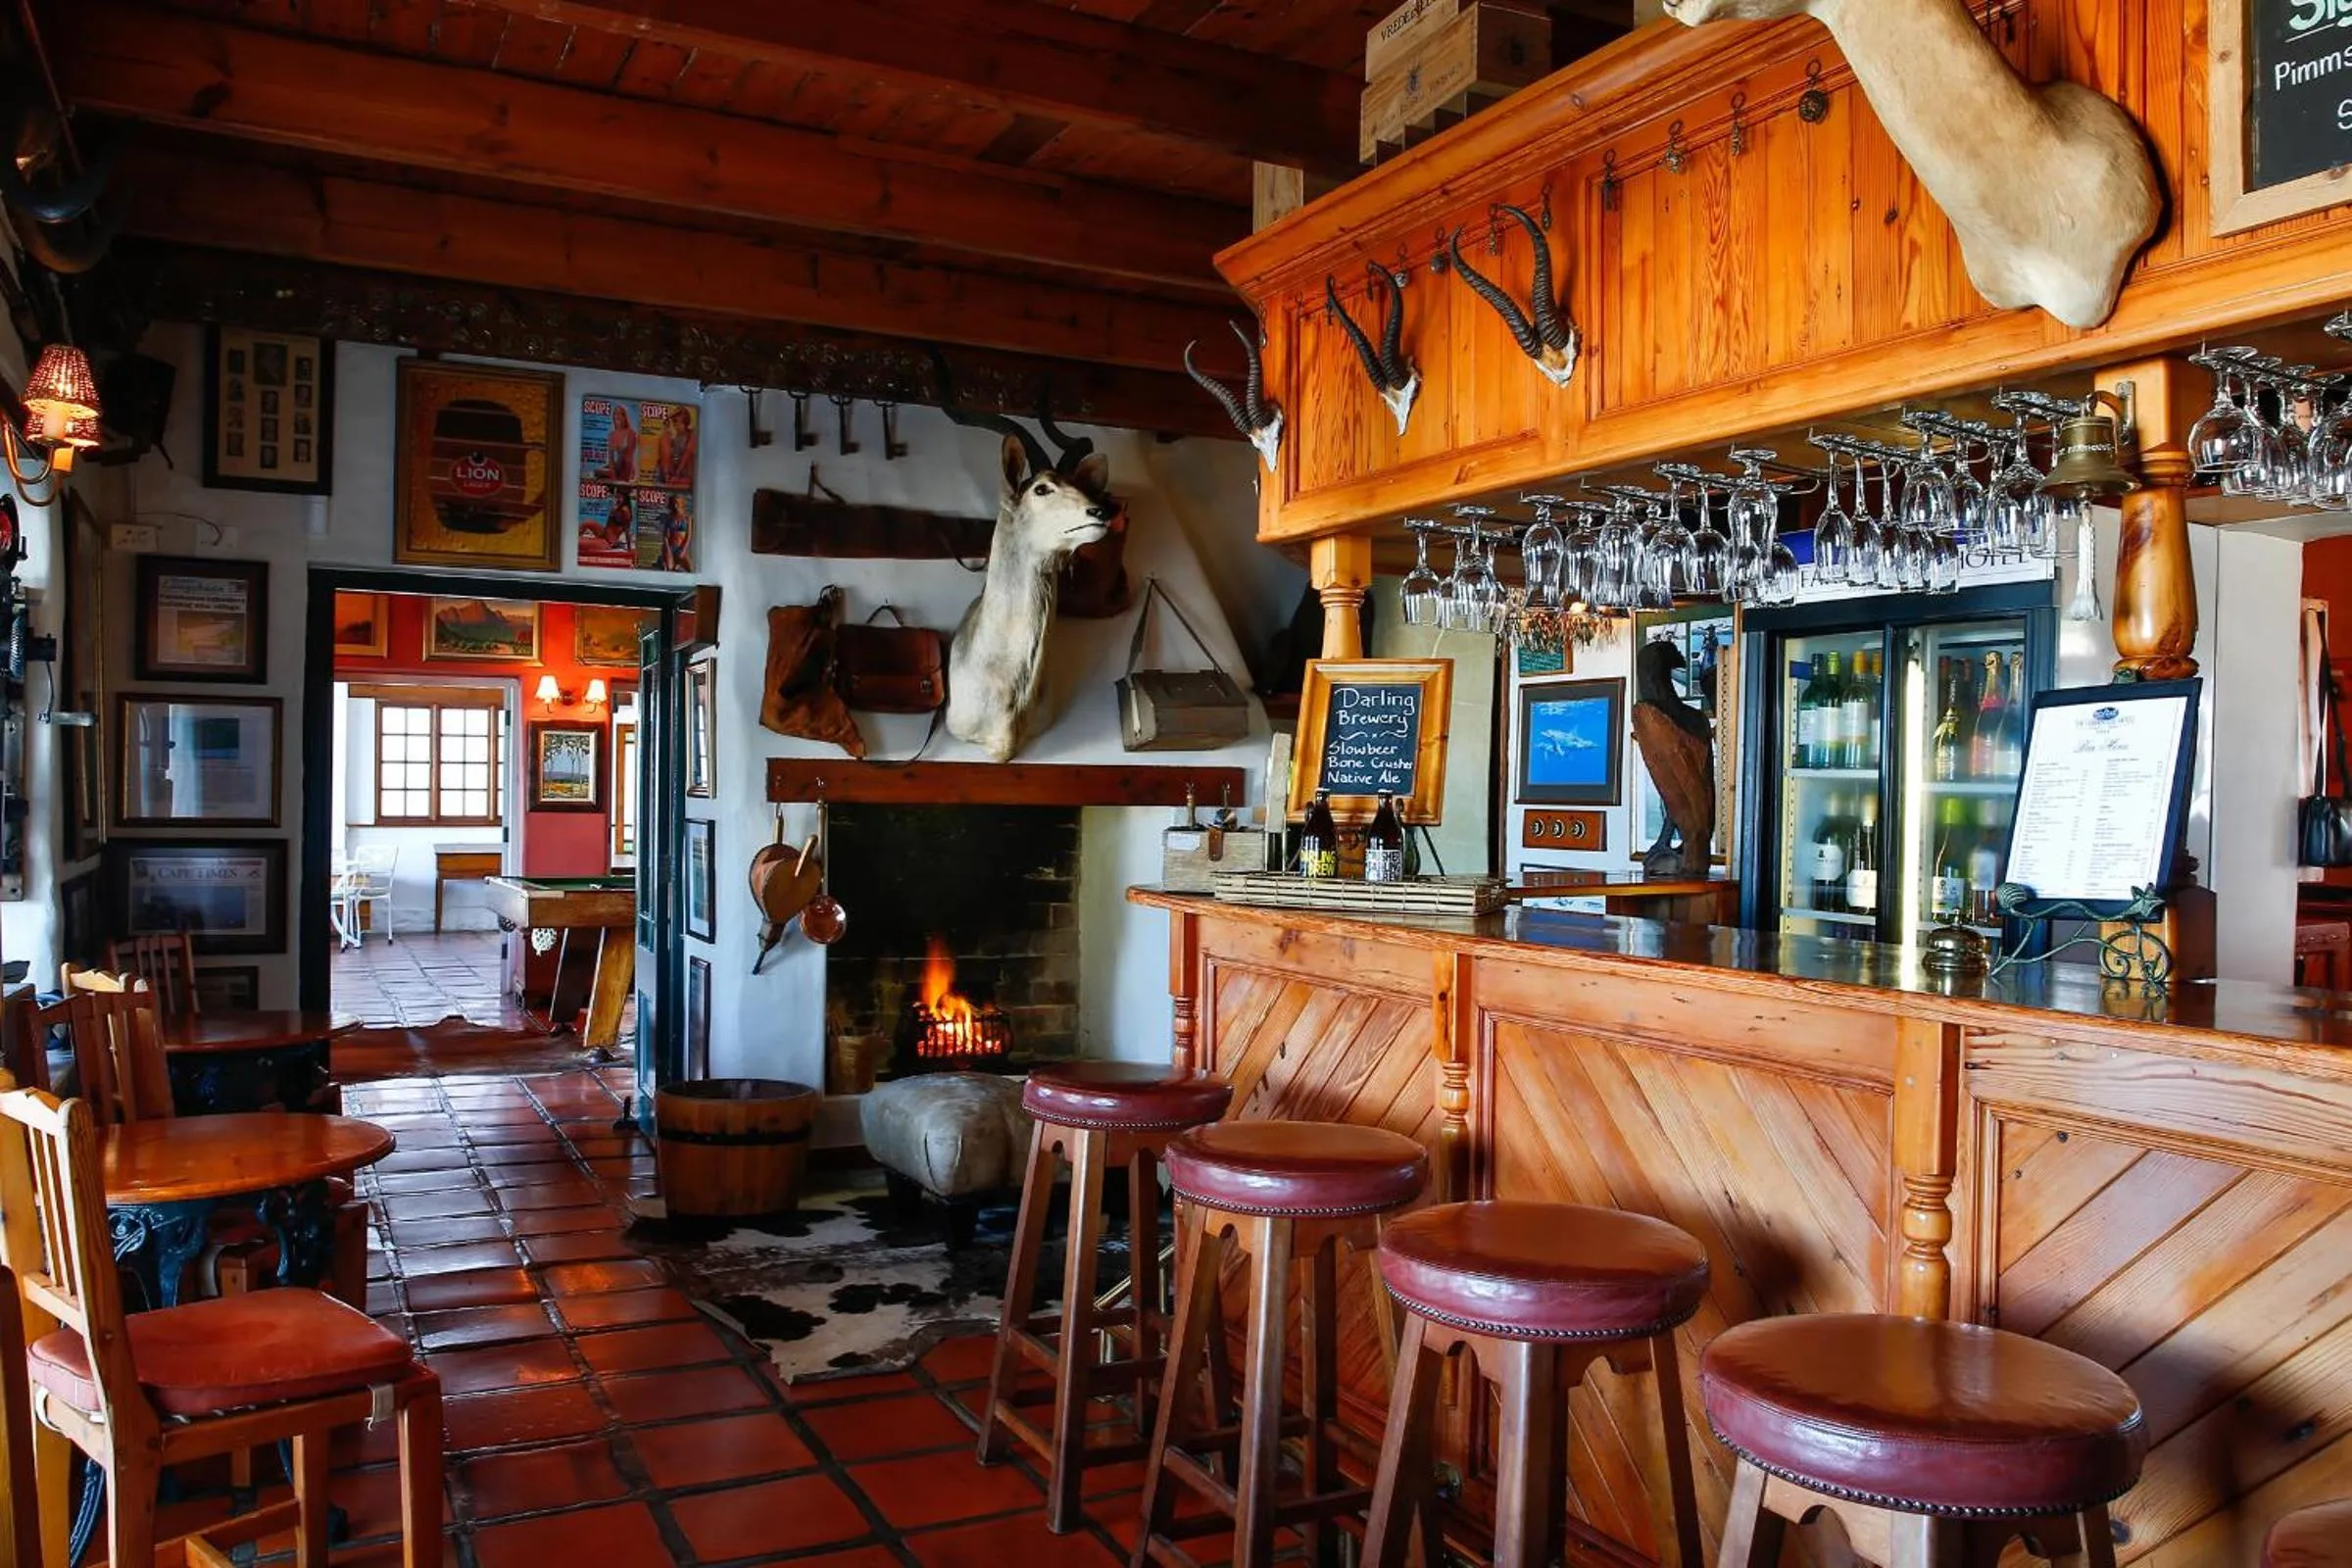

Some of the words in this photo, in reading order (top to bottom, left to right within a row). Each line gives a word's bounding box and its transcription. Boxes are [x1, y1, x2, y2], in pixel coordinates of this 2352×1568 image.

[583, 400, 612, 416] SCOPE
[642, 405, 668, 419] SCOPE
[456, 466, 500, 481] LION
[580, 483, 607, 498] SCOPE
[639, 490, 666, 504] SCOPE
[1334, 688, 1415, 715] Darling
[1336, 710, 1408, 733] Brewery
[1328, 741, 1398, 755] Slowbeer
[1327, 756, 1365, 768] Bone
[1371, 757, 1413, 769] Crusher
[1327, 770, 1372, 784] Native
[1378, 769, 1401, 784] Ale
[197, 866, 238, 879] TIMES
